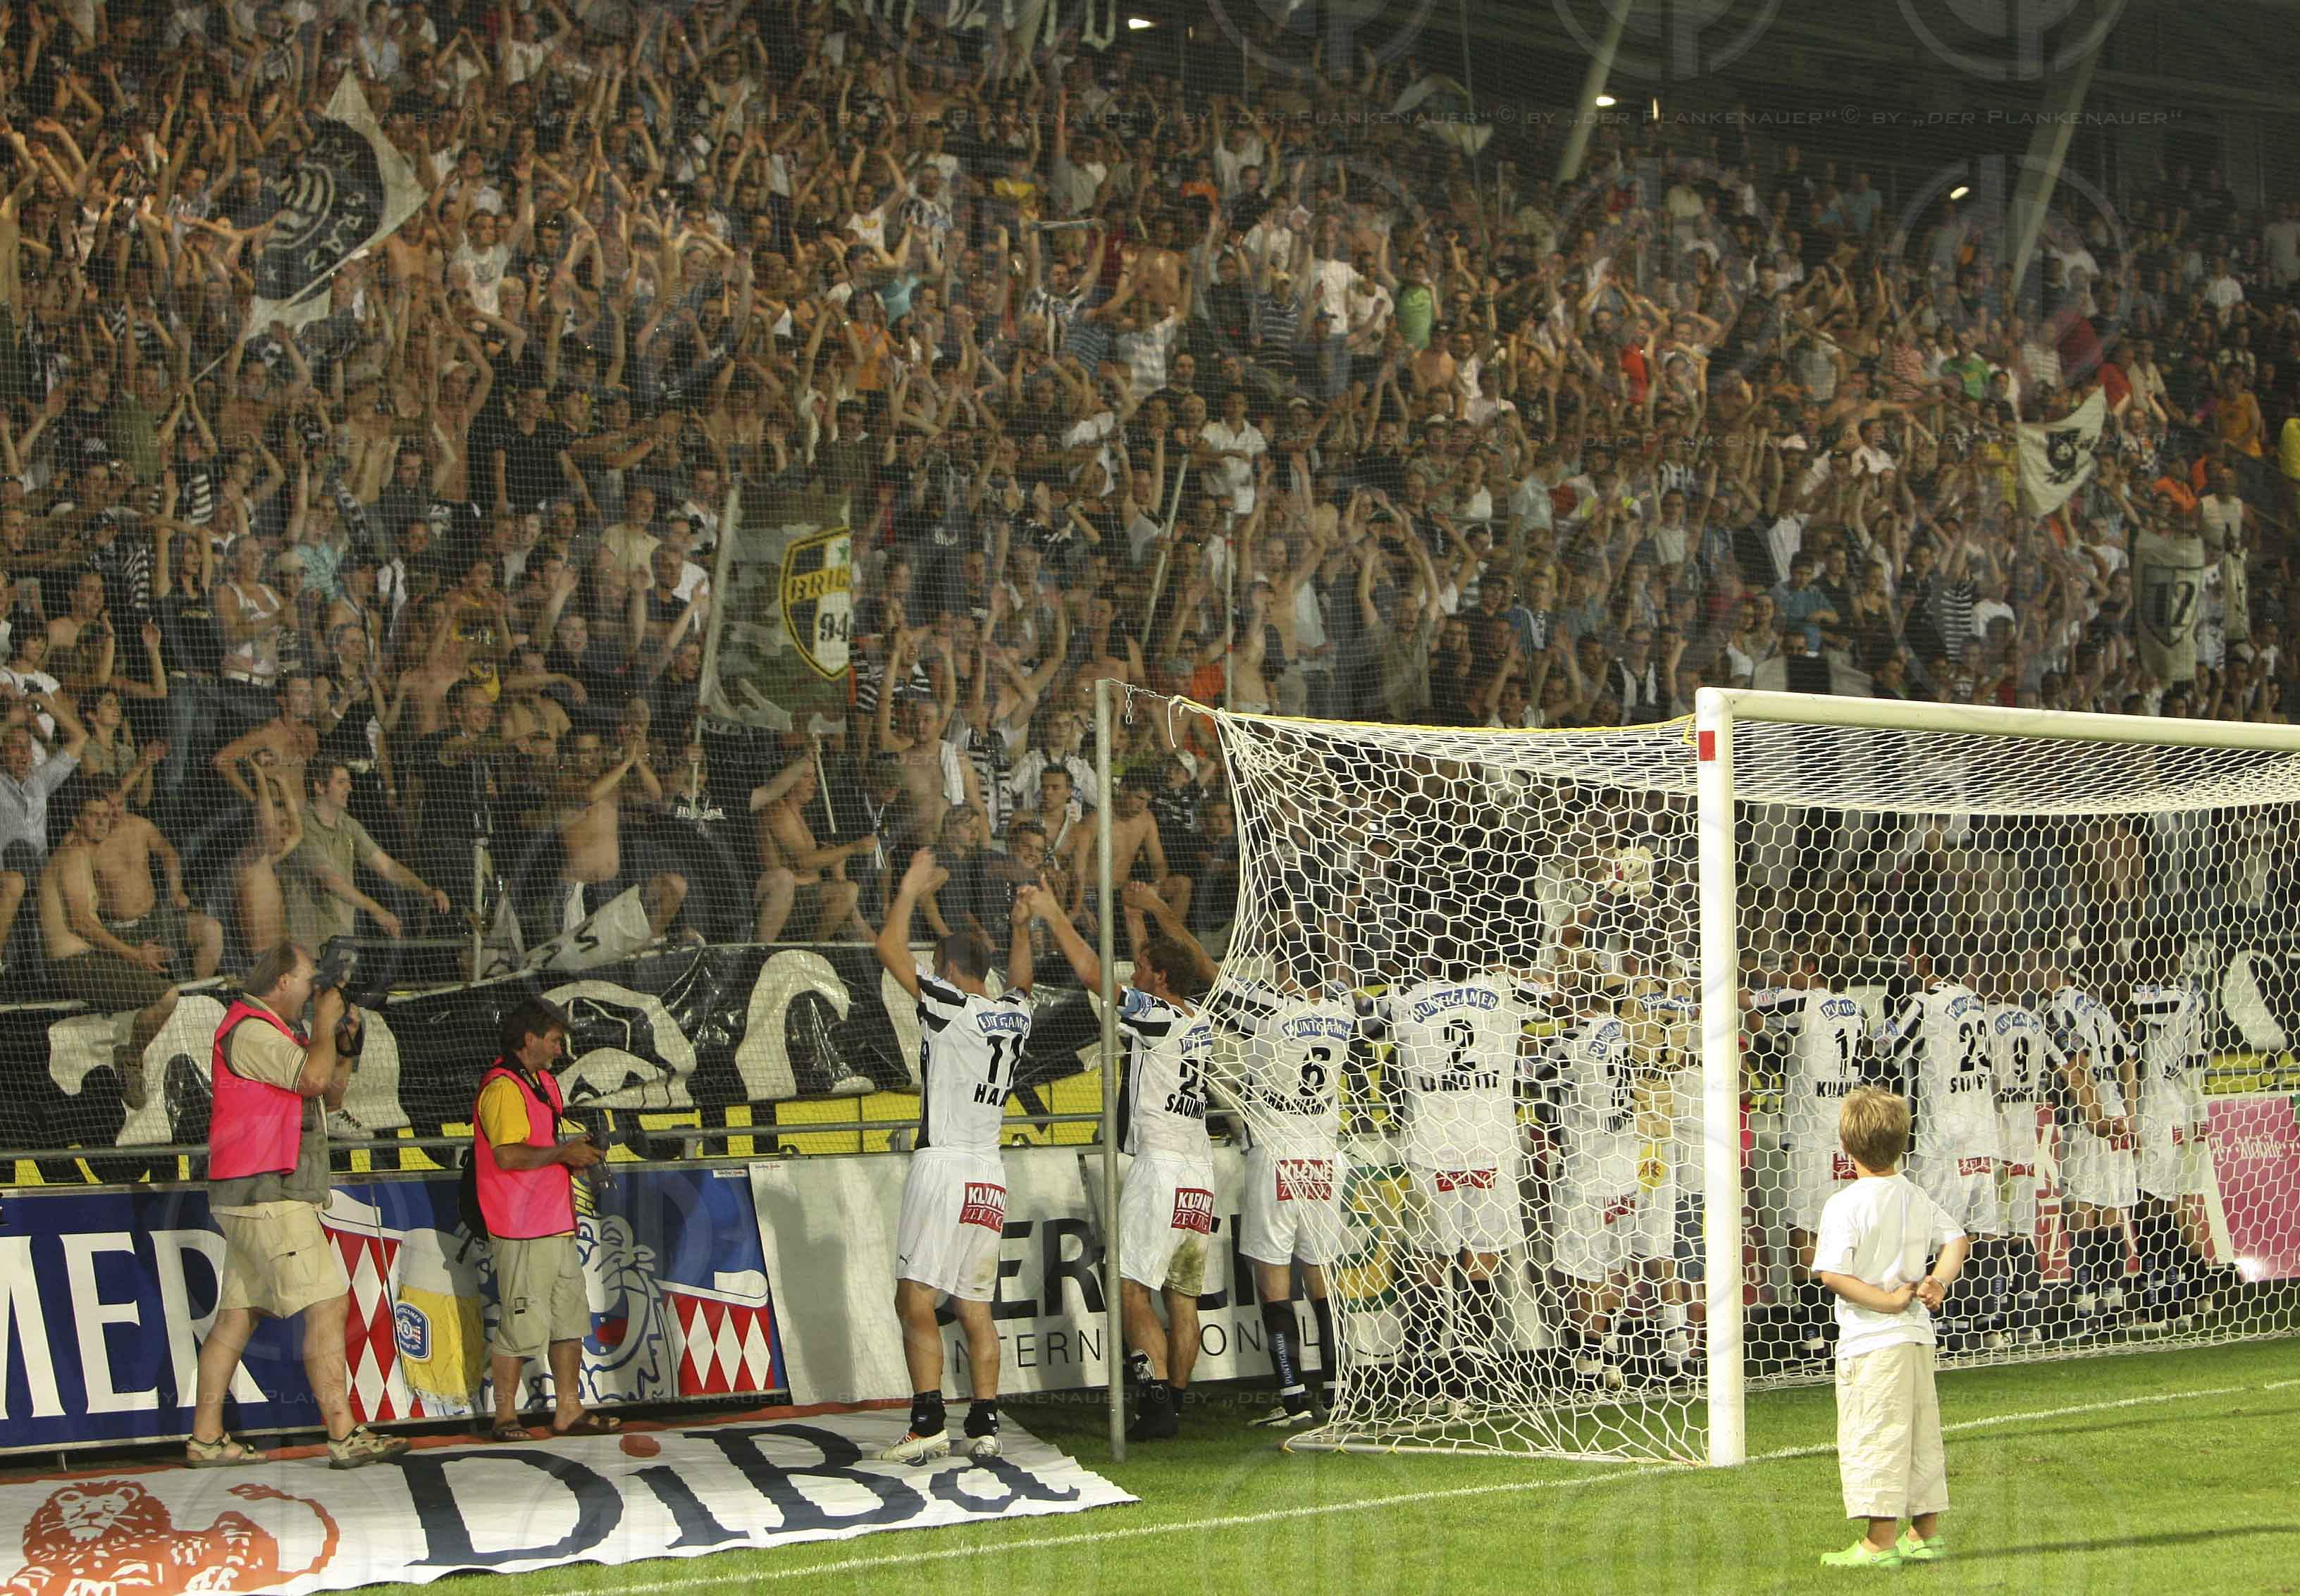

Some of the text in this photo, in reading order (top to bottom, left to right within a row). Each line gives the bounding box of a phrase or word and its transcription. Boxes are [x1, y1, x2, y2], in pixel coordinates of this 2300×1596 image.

[1443, 1019, 1476, 1072] 2
[2013, 1037, 2029, 1083] 9
[1298, 1046, 1331, 1097] 6
